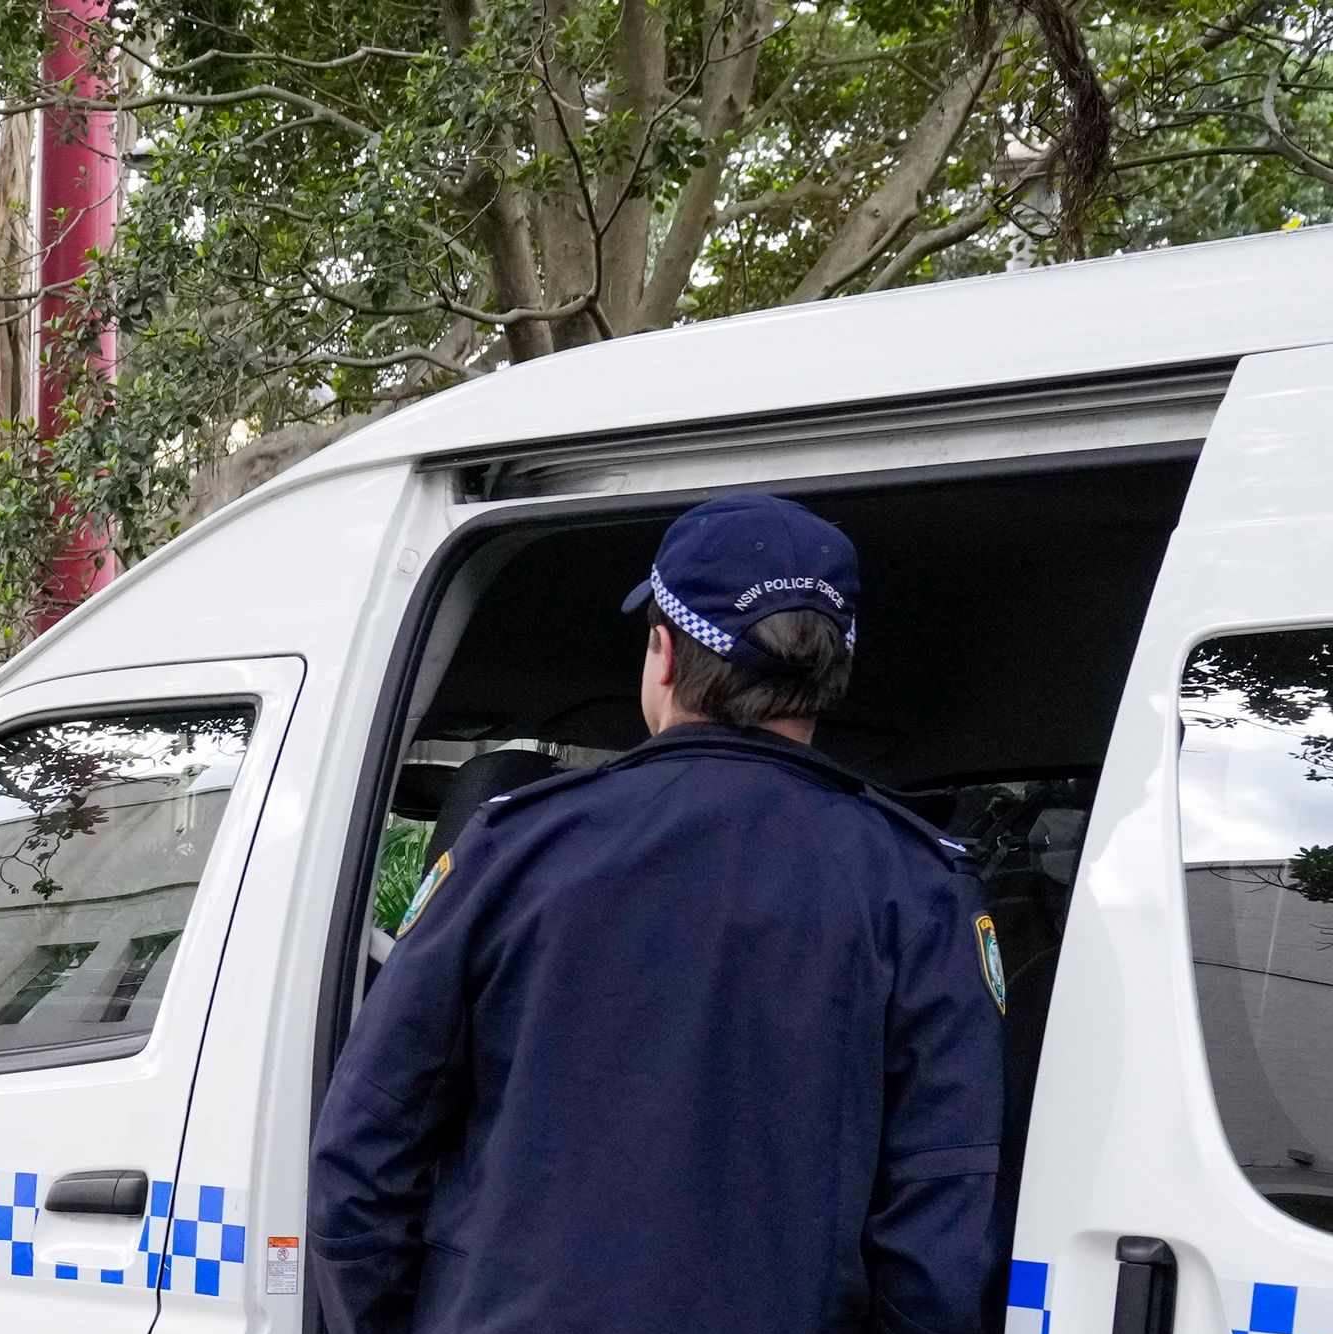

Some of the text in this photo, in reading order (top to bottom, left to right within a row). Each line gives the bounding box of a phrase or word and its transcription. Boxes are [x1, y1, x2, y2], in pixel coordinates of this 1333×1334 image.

[734, 577, 845, 611] NSW POLICE FORCE
